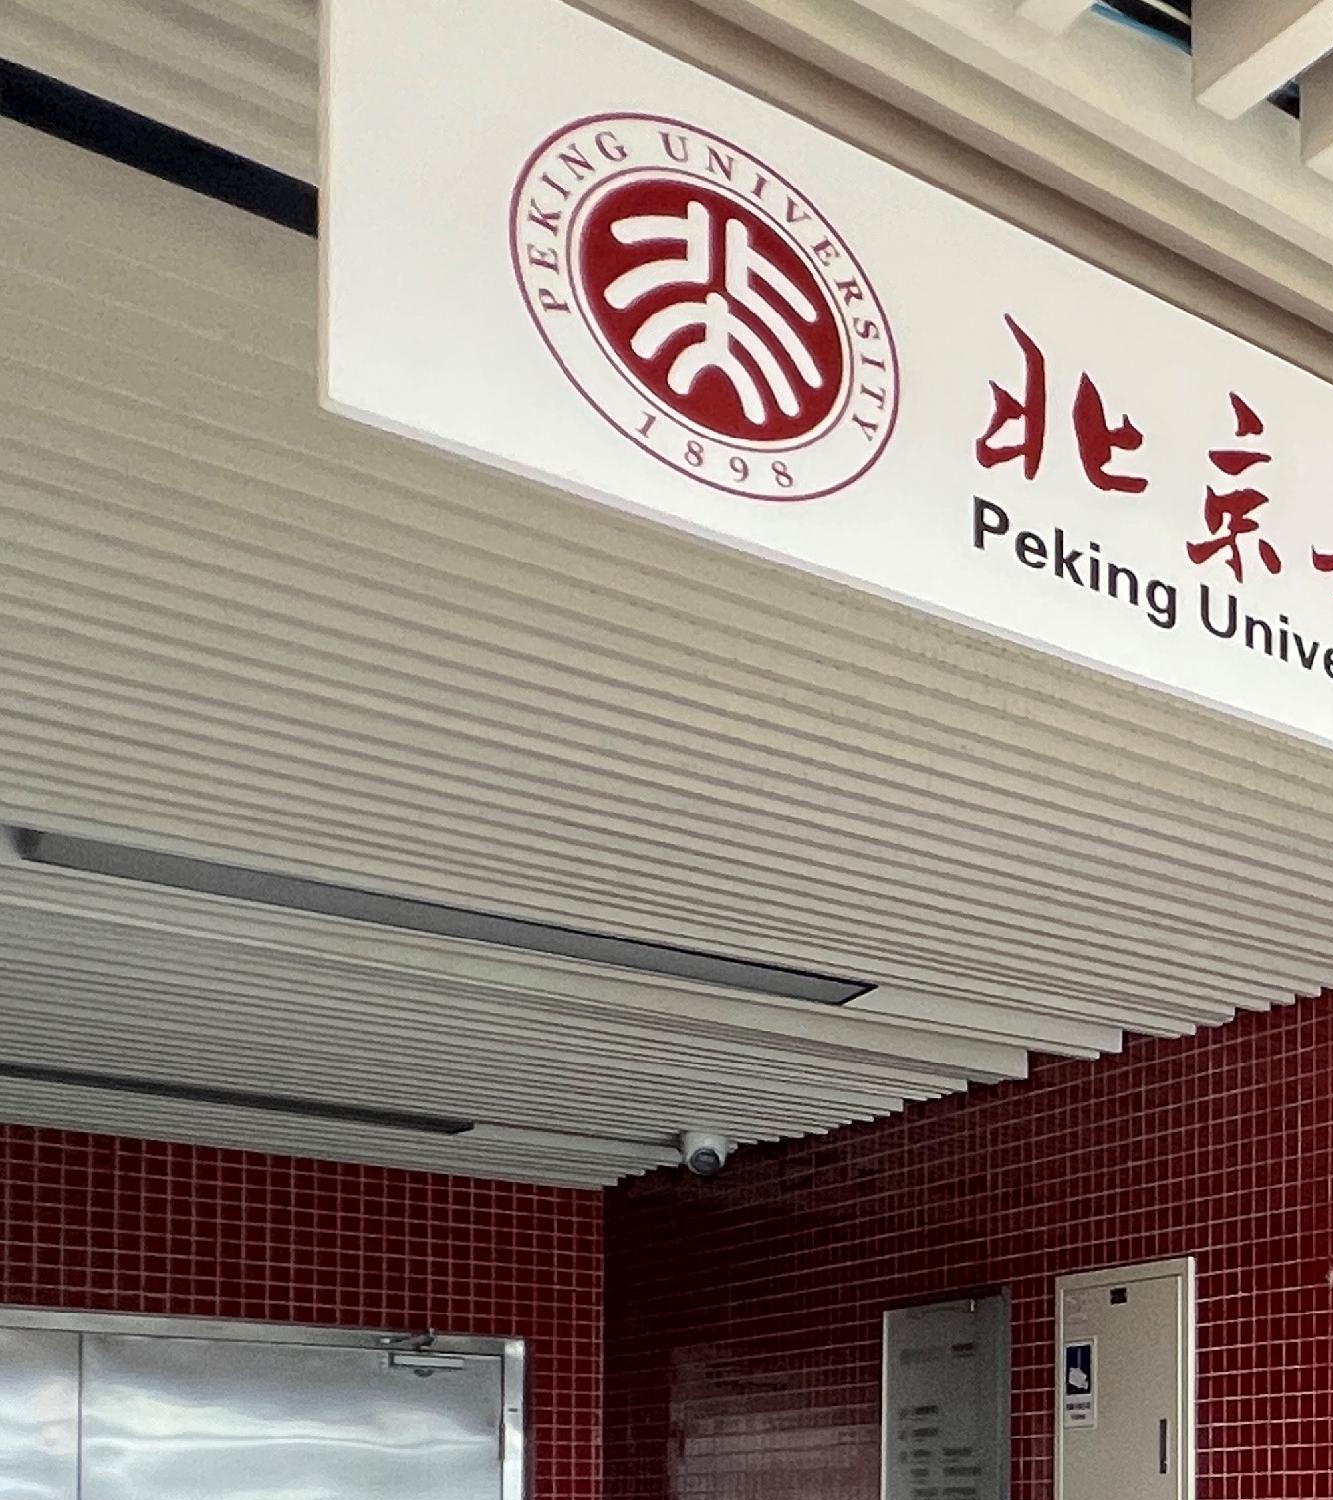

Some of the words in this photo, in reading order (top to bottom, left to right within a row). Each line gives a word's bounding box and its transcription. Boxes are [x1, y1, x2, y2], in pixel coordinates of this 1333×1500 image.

[527, 130, 630, 315] PEKING
[657, 130, 887, 442] UNIVERSITY
[635, 411, 796, 489] 1898
[972, 495, 1178, 629] Peking
